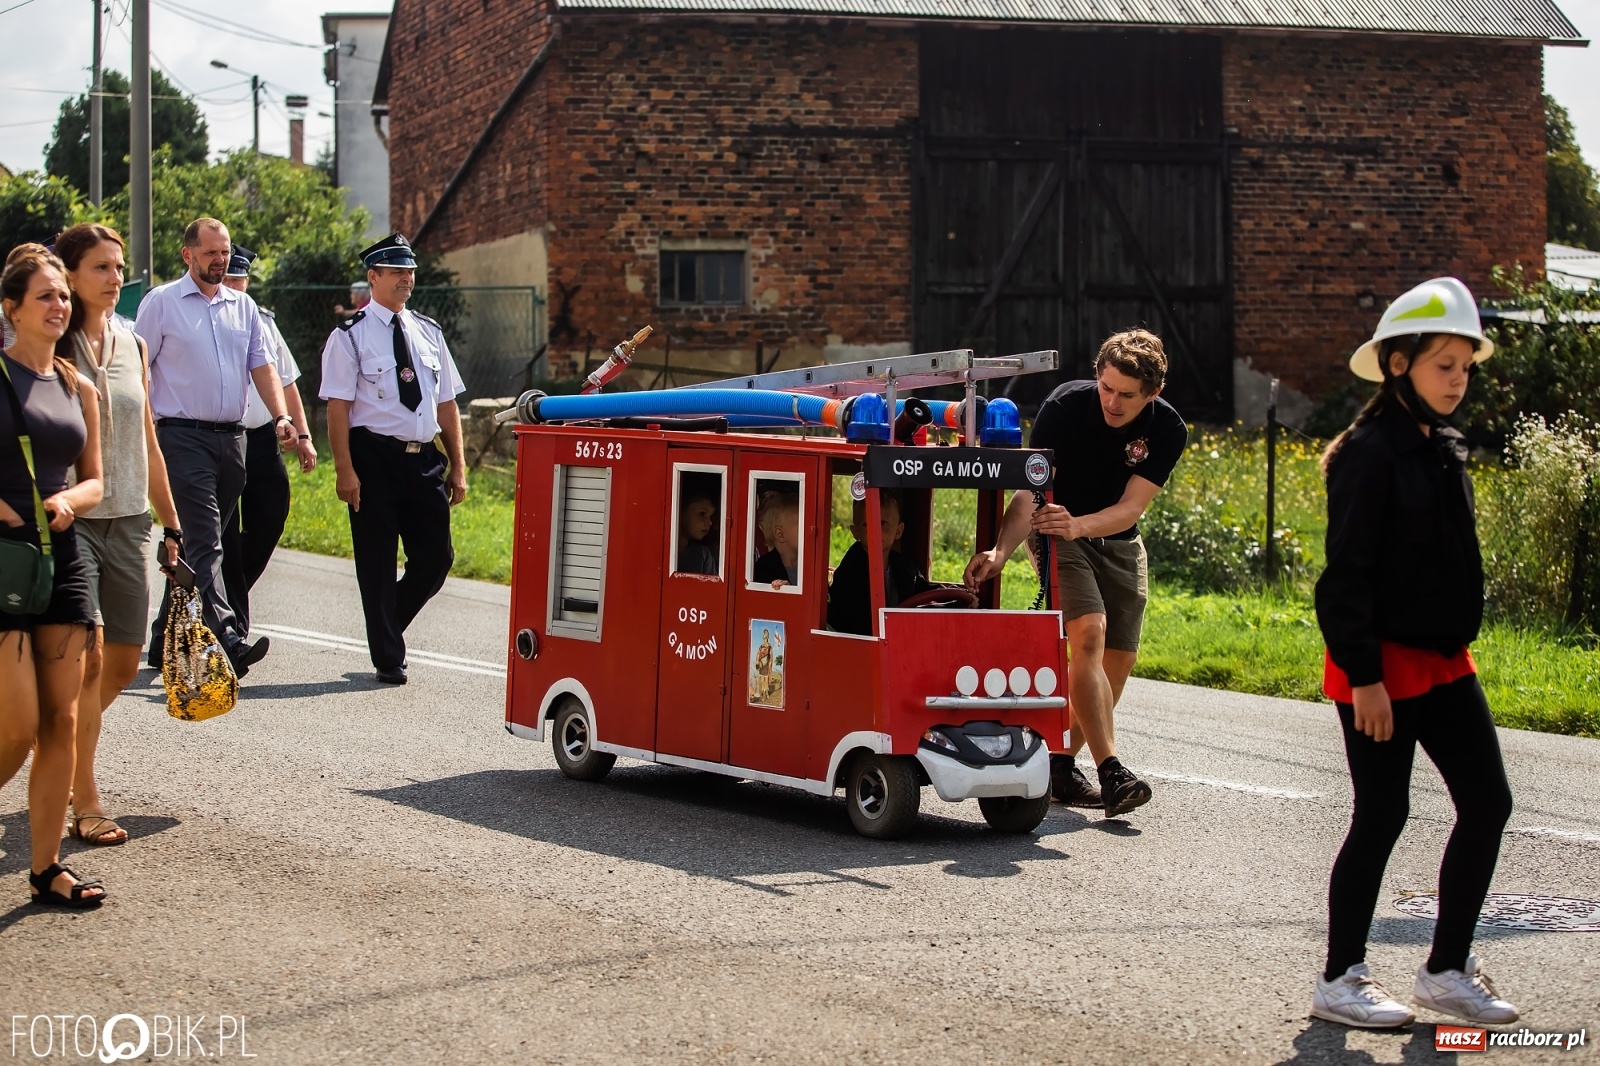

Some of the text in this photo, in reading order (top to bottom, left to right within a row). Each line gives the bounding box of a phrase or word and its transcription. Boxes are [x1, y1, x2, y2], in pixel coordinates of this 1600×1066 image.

[893, 459, 924, 476] OSP
[933, 456, 1002, 478] GAMÓW
[678, 607, 708, 625] OSP
[668, 635, 719, 660] GAMÓW
